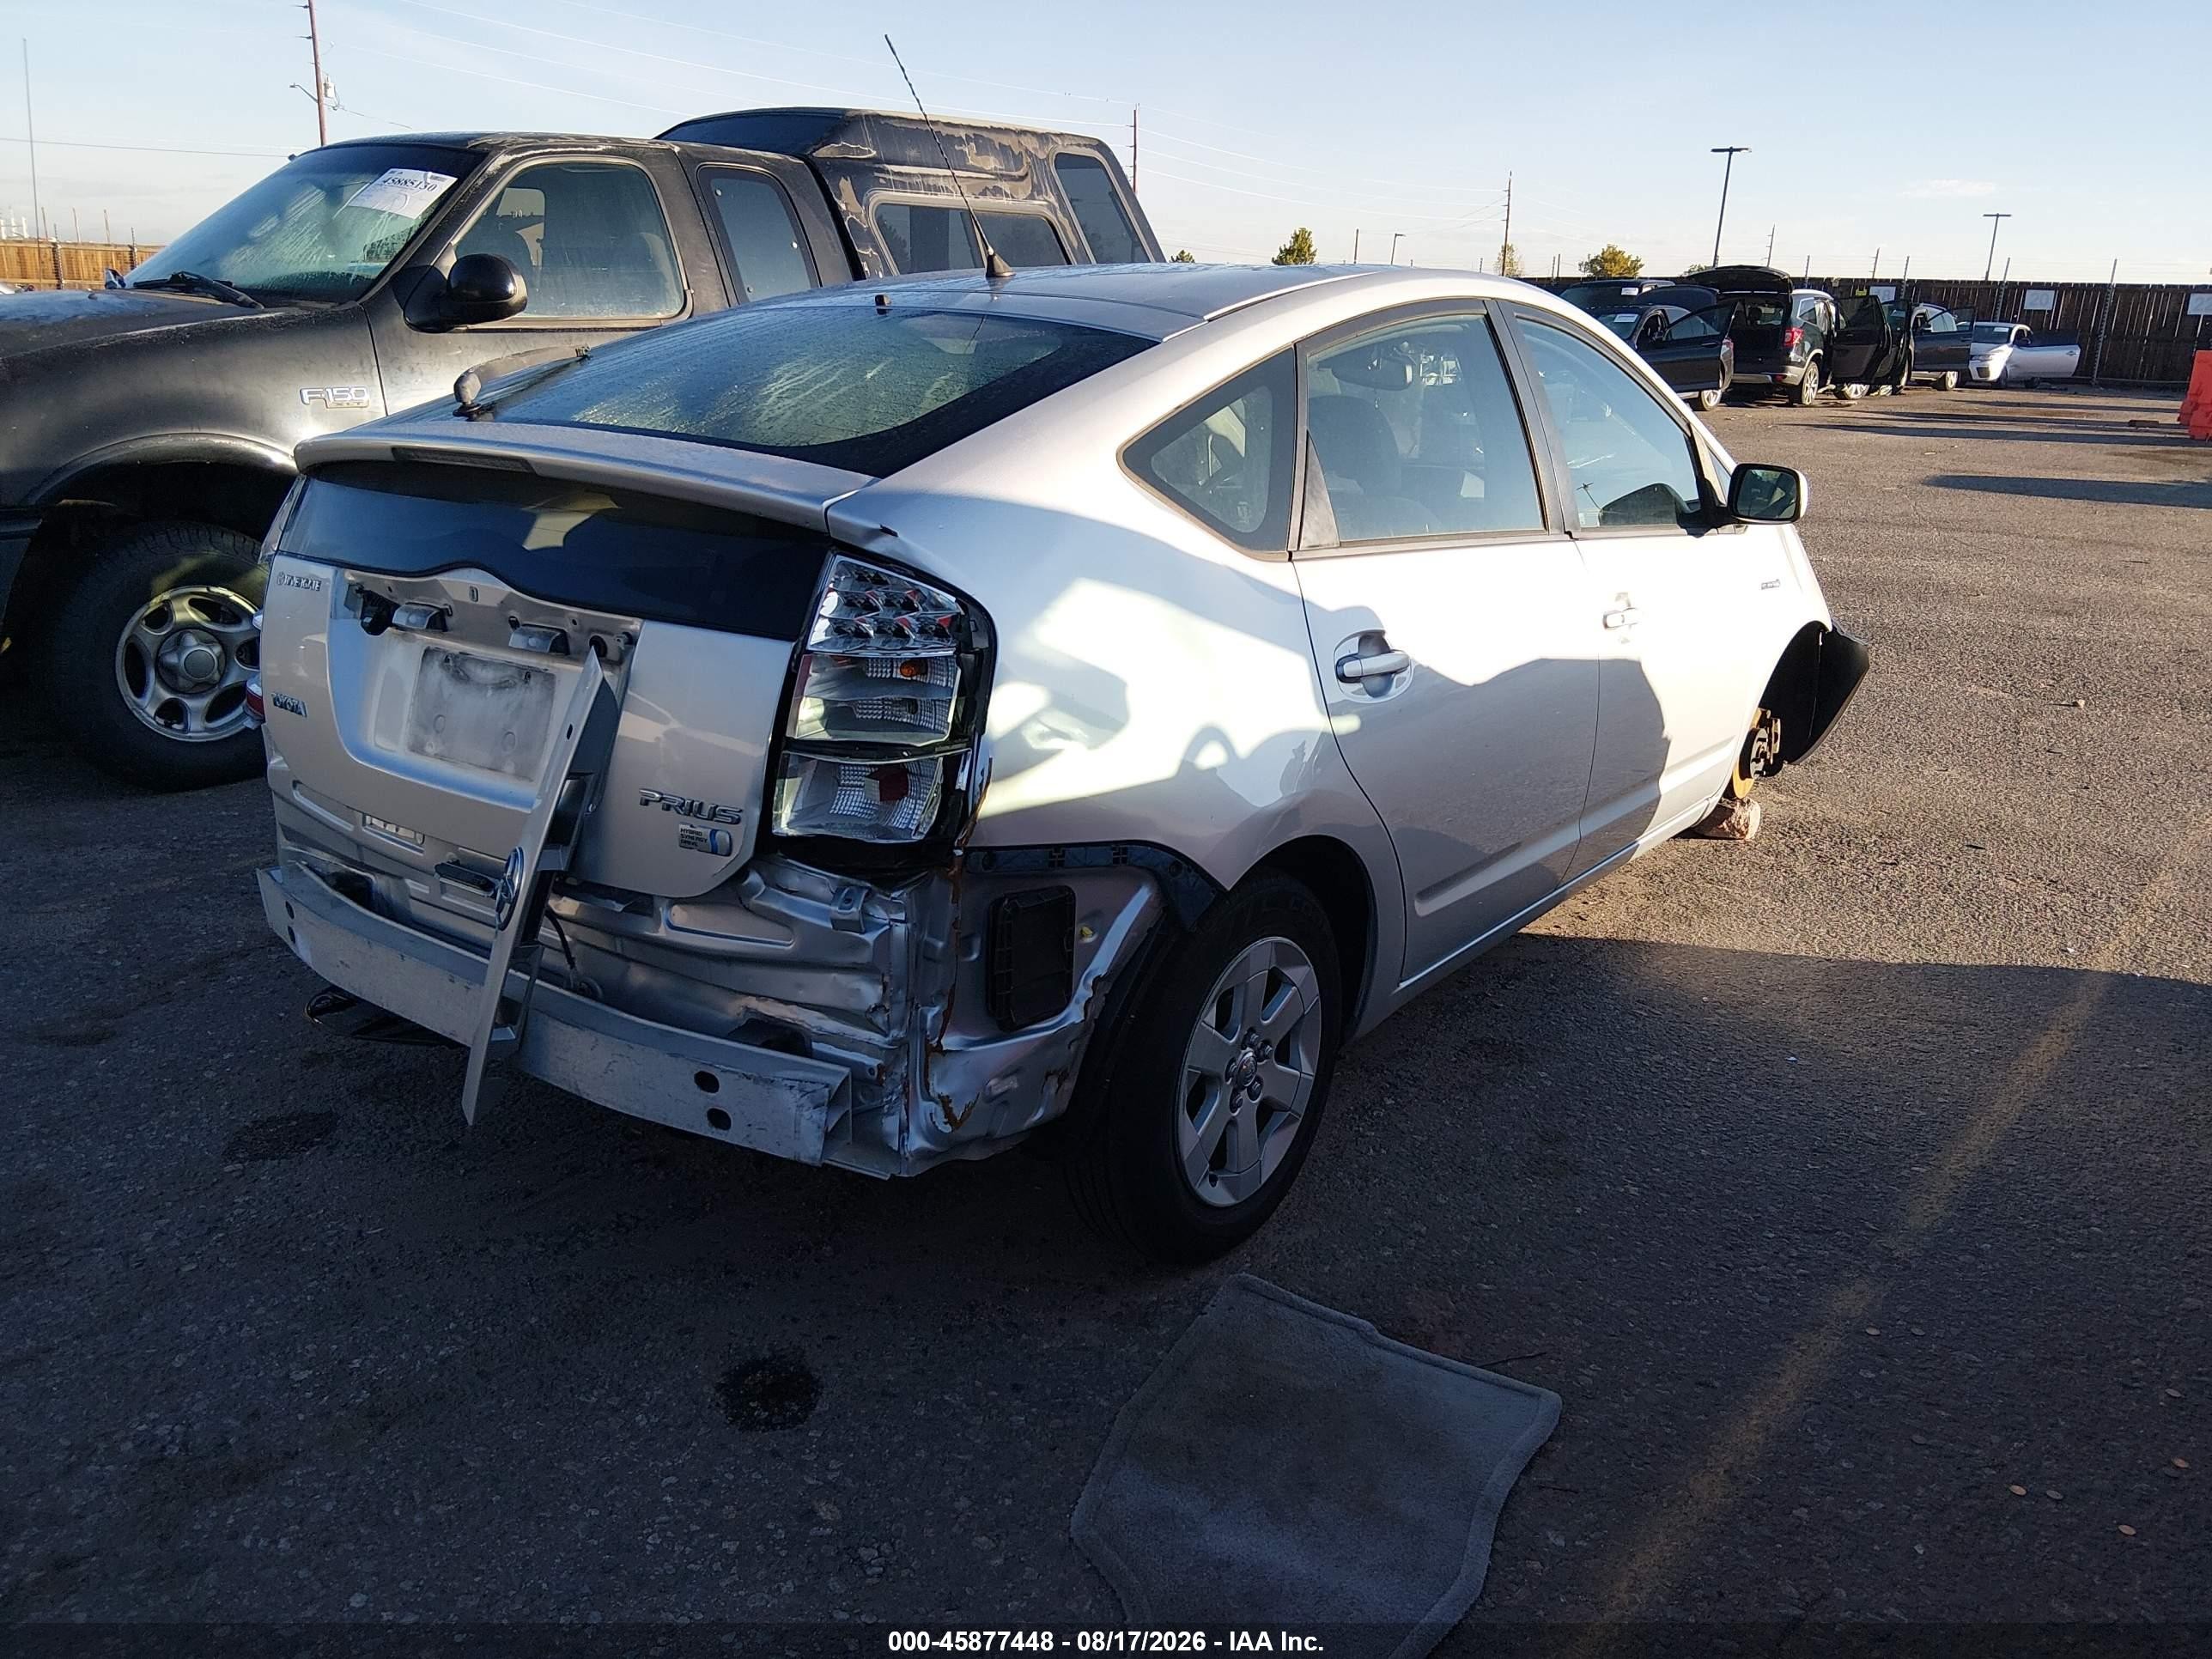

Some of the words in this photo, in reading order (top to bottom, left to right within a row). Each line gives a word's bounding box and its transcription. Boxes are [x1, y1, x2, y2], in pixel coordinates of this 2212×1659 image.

[2030, 293, 2049, 307] 20
[270, 692, 307, 718] TOYOTA
[639, 788, 743, 824] PRIUS
[680, 828, 702, 836] HYBRID
[680, 833, 708, 843] SYNERGY
[680, 838, 698, 847] DRIVE
